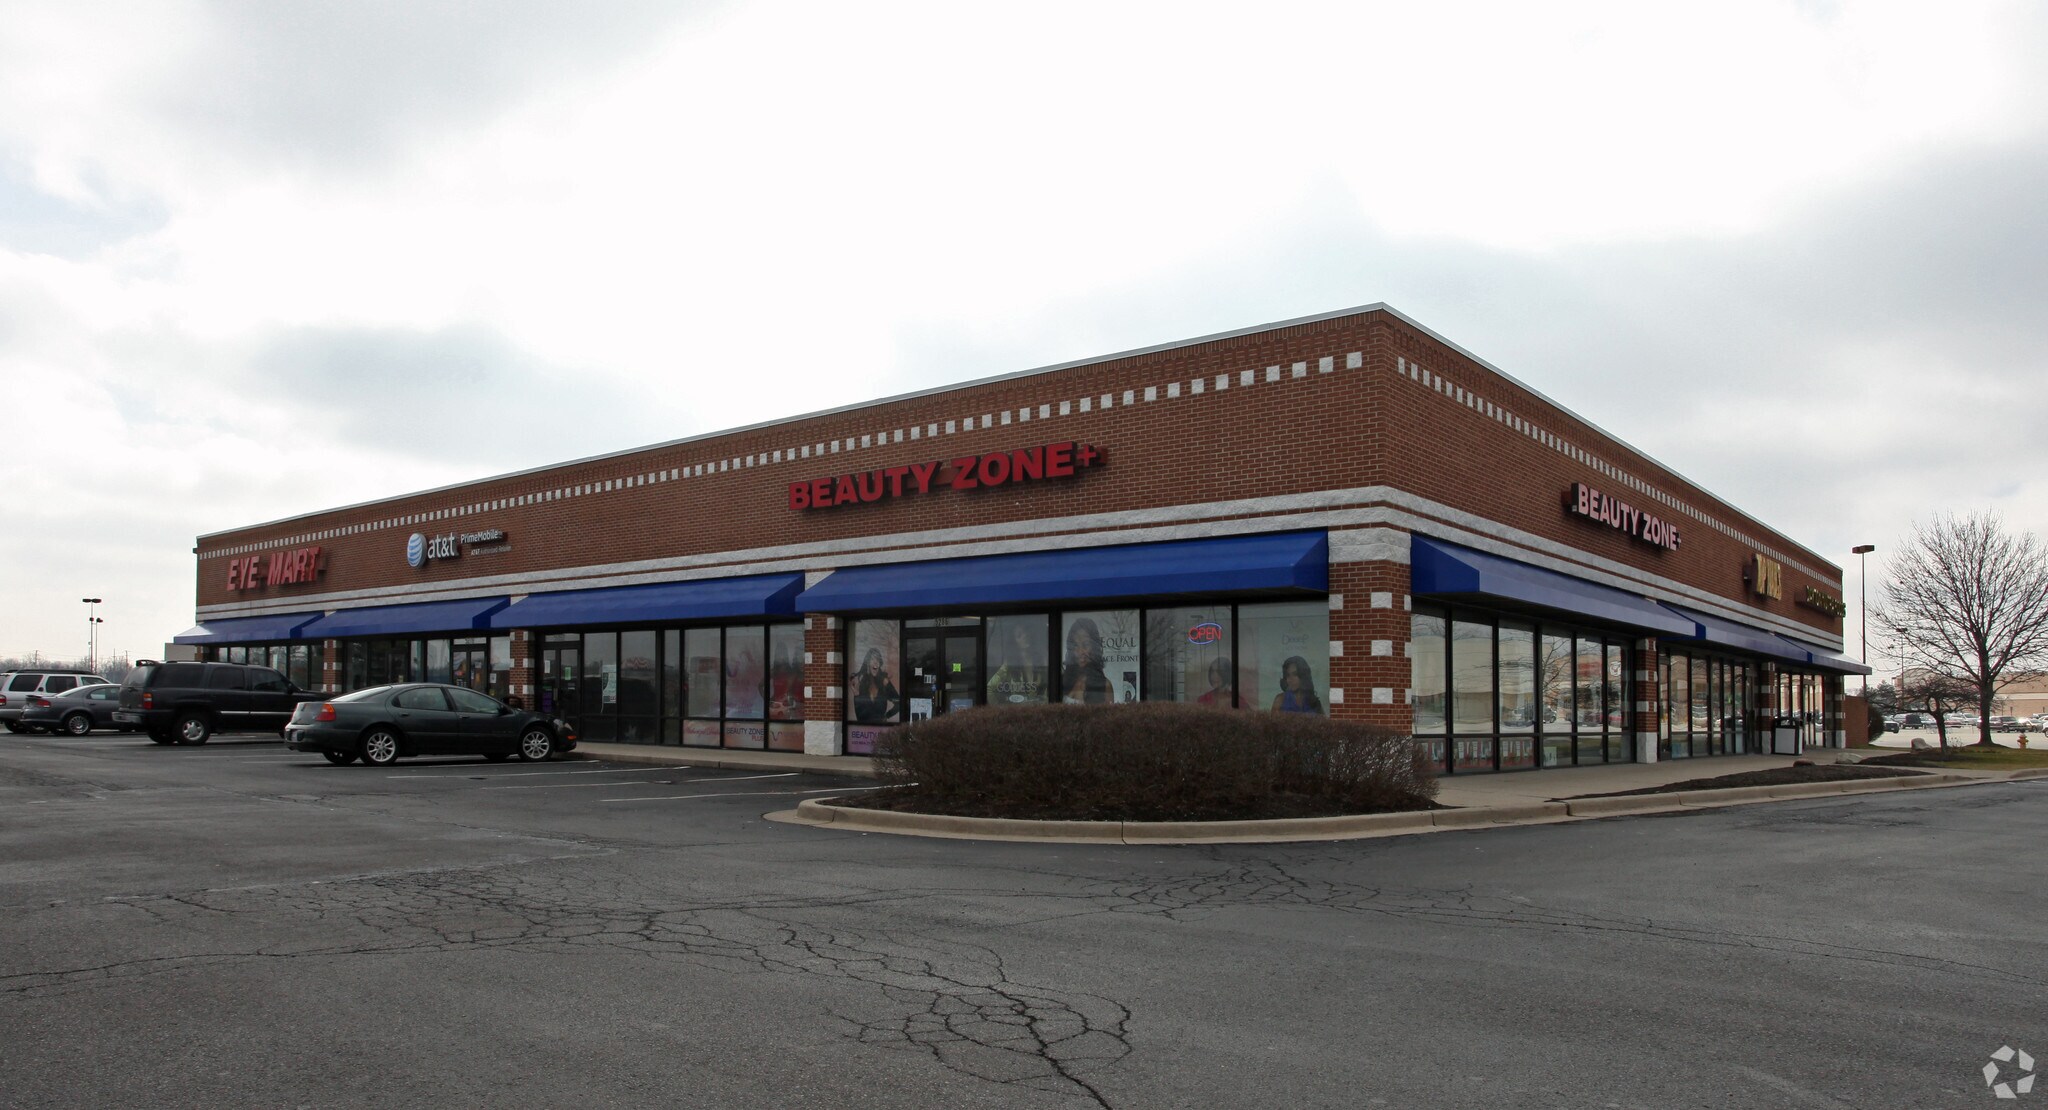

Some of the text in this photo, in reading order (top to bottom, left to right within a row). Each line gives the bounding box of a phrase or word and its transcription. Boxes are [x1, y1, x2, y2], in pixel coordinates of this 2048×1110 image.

[789, 441, 1098, 510] BEAUTY ZONE+
[1578, 482, 1640, 536] BEAUTY
[460, 529, 499, 544] PrimeMobile
[427, 532, 457, 560] at&t
[227, 547, 321, 591] EYE MART
[1188, 626, 1223, 641] OPEN
[1100, 636, 1137, 650] EQUAL
[997, 681, 1037, 693] GODDESS
[726, 727, 747, 735] BEAUTY
[851, 731, 876, 739] BEAUTY
